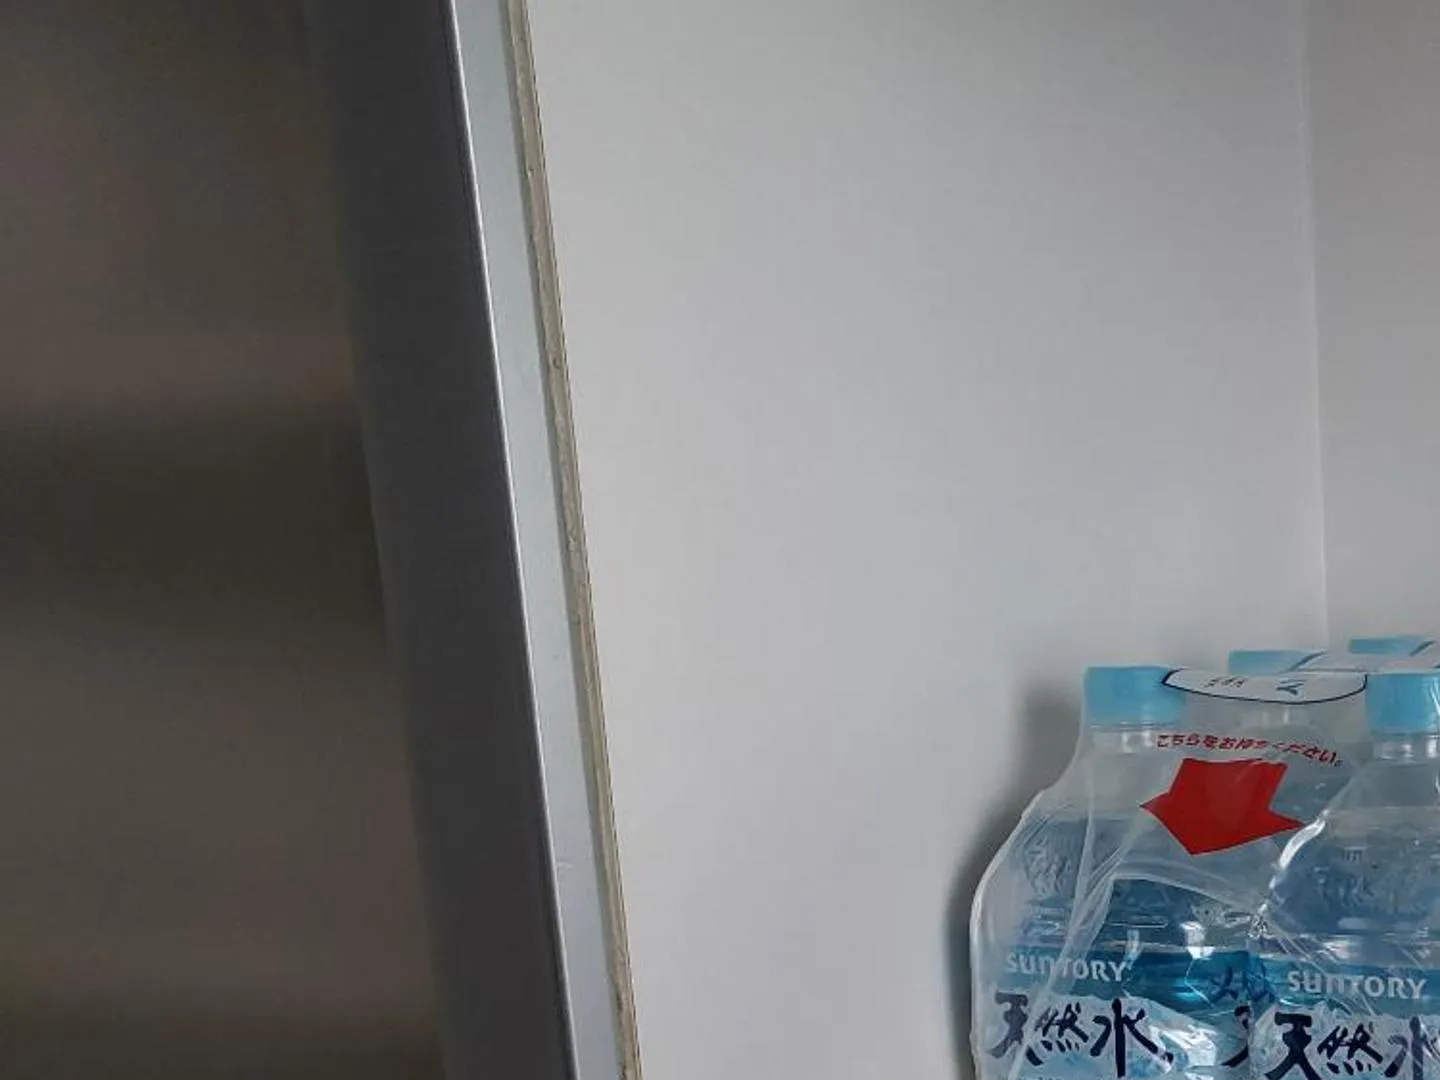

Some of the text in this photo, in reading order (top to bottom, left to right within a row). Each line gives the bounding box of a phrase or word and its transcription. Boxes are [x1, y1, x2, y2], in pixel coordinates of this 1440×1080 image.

[1002, 953, 1127, 982] SUNTORY
[1287, 970, 1427, 1000] SUNTORY
[990, 992, 1174, 1078] 天然水
